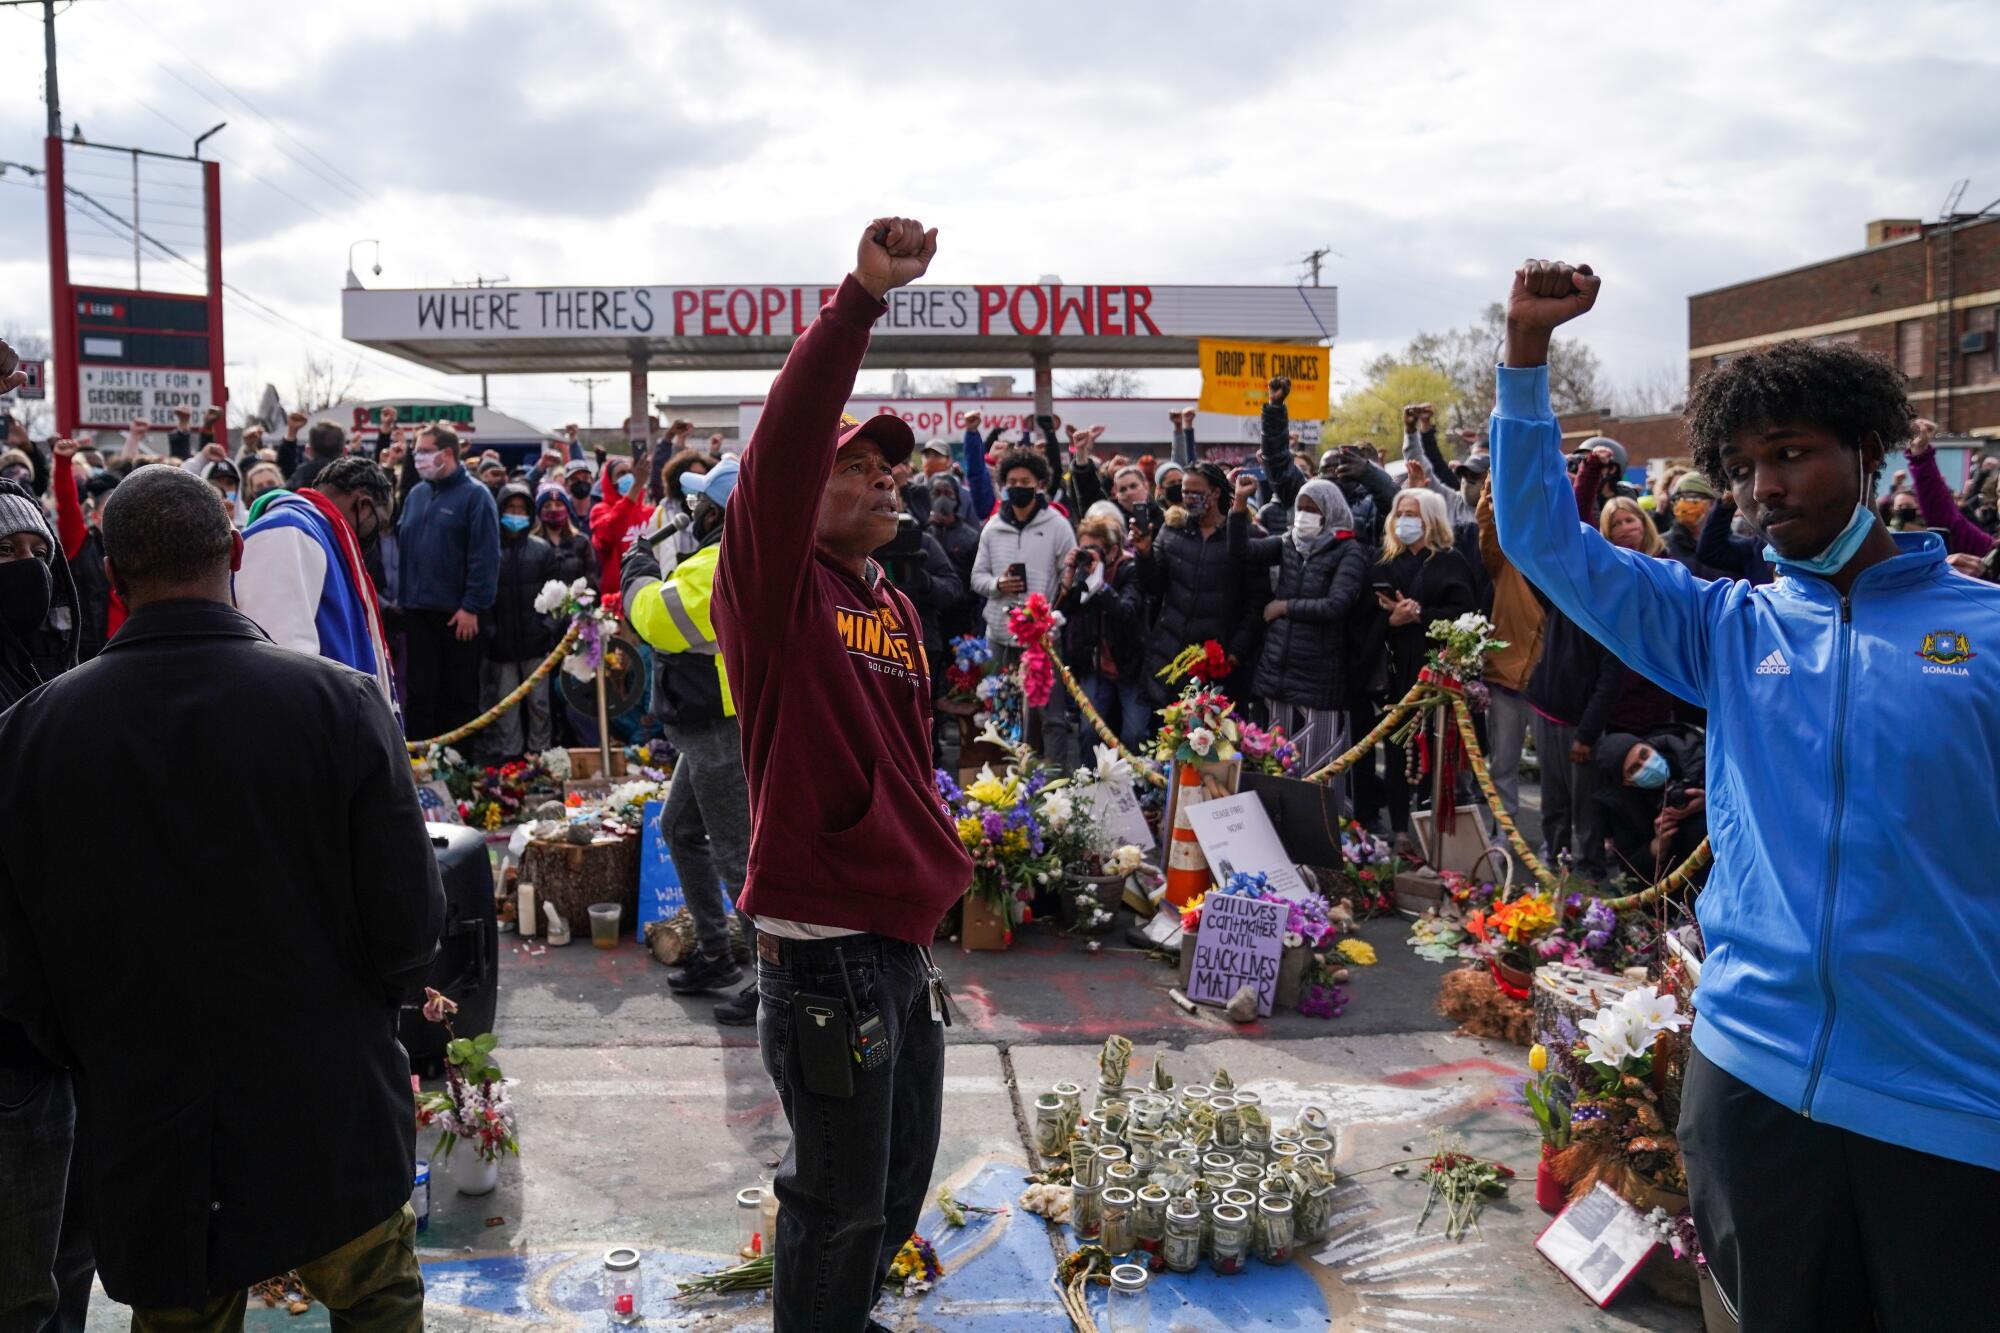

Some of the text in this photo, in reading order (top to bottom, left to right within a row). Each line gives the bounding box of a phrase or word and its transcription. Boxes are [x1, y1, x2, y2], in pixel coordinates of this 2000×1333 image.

[418, 292, 521, 332] WHERE
[973, 284, 1163, 337] POWER
[1215, 350, 1246, 378] DROP
[1271, 354, 1319, 382] CHARGES
[98, 371, 190, 388] JUSTICE FOR
[87, 389, 201, 408] GEORGE FLOYD
[868, 661, 905, 678] GOLDEN
[1755, 664, 1791, 676] adidas
[1921, 665, 1970, 677] SOMALIA
[1237, 900, 1278, 921] LIVES
[1219, 932, 1257, 949] UNTIL
[1195, 945, 1238, 973] BLACK
